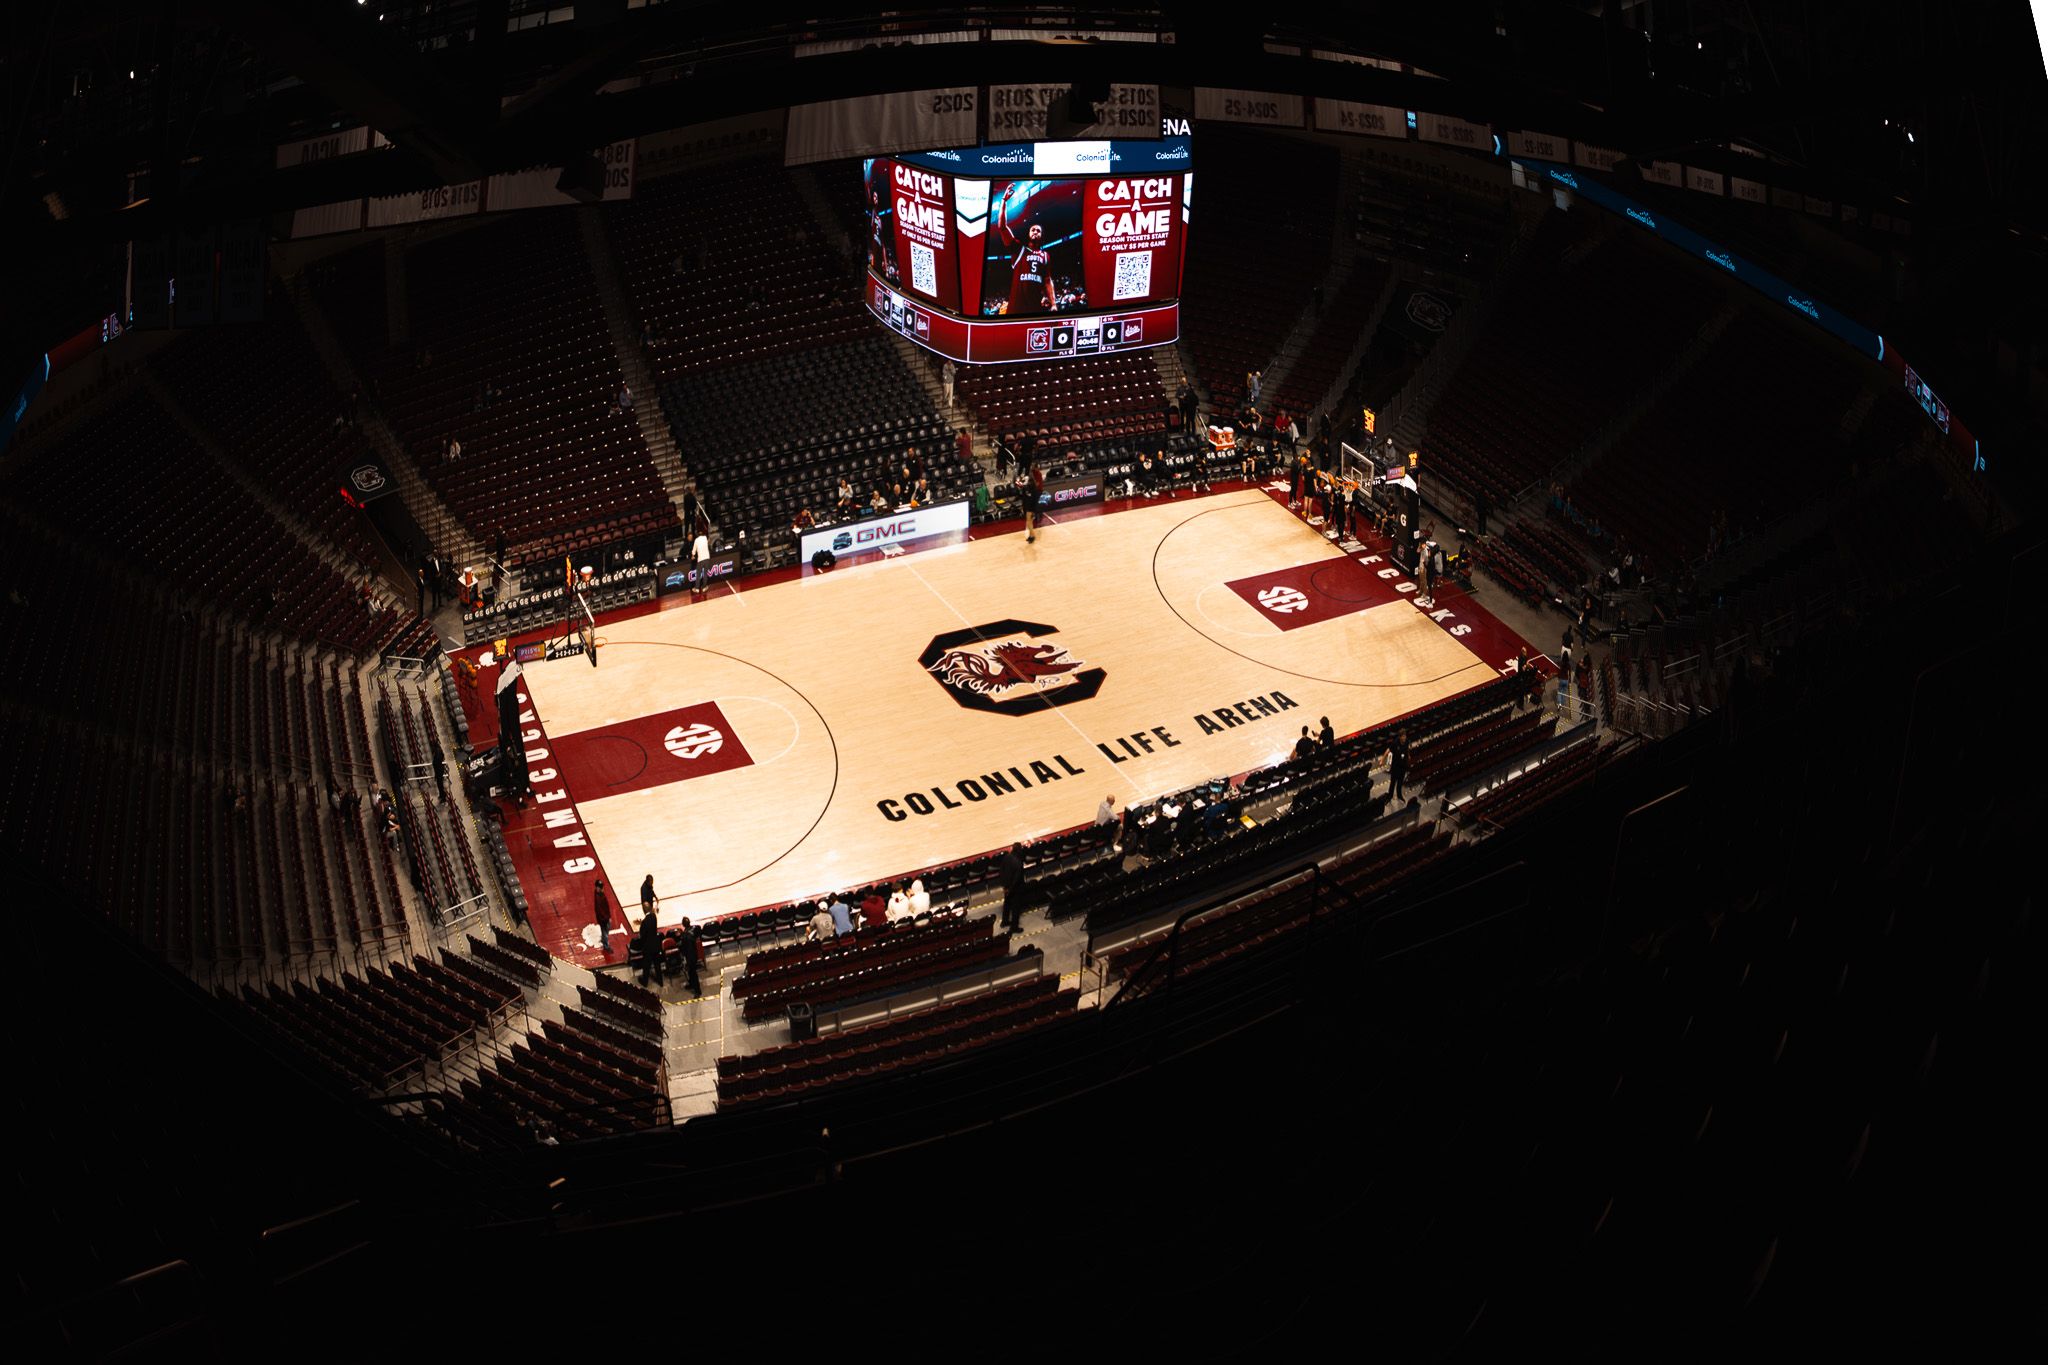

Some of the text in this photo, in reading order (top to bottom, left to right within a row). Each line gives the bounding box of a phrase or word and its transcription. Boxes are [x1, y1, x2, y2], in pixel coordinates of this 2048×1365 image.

[981, 155, 1018, 163] Colonial
[1076, 154, 1107, 162] Colonial
[1155, 151, 1181, 160] Colonial
[894, 165, 943, 198] CATCH
[1097, 178, 1173, 201] CATCH
[914, 191, 922, 203] A
[1131, 199, 1142, 211] A
[896, 197, 945, 235] GAME
[1095, 209, 1171, 237] GAME
[1099, 232, 1169, 244] SEASON TICKETS START
[1111, 243, 1128, 251] ONLY
[1149, 240, 1166, 248] GAME
[1026, 254, 1044, 263] SOUTH
[1031, 262, 1038, 273] 5
[1057, 332, 1069, 344] 0
[1107, 328, 1117, 339] 0
[1054, 484, 1097, 503] GMC
[856, 519, 917, 544] GMC
[1257, 585, 1310, 614] SEC
[663, 722, 724, 760] SEC
[876, 689, 1300, 823] COLONIAL LIFE ARENA
